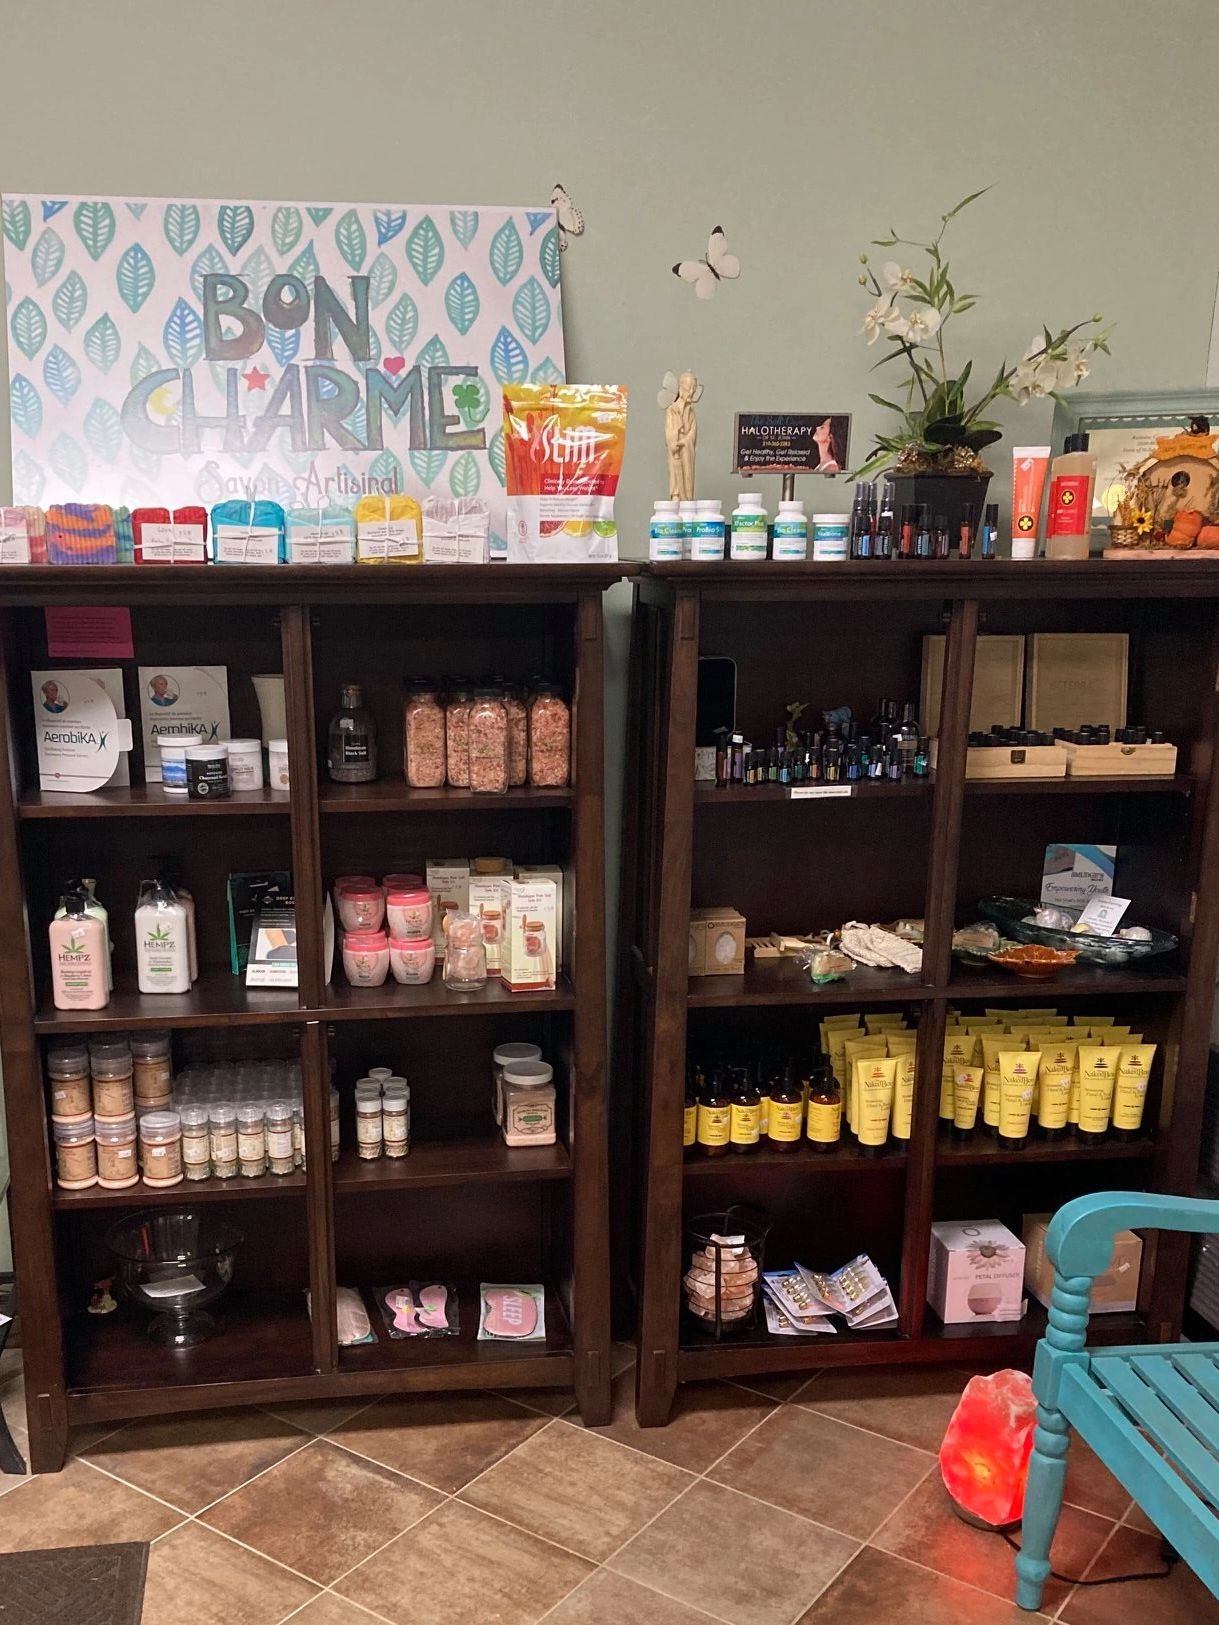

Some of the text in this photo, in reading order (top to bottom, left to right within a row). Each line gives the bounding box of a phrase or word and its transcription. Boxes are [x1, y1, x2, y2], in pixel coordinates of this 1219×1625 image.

[201, 273, 374, 361] BON
[120, 363, 488, 454] CHARME
[741, 426, 812, 435] HALOTHERAPY
[43, 731, 97, 744] AerobiKA
[1045, 882, 1109, 895] Empowering Youth
[58, 953, 91, 961] HEMPZ
[502, 1295, 523, 1326] SLEEP
